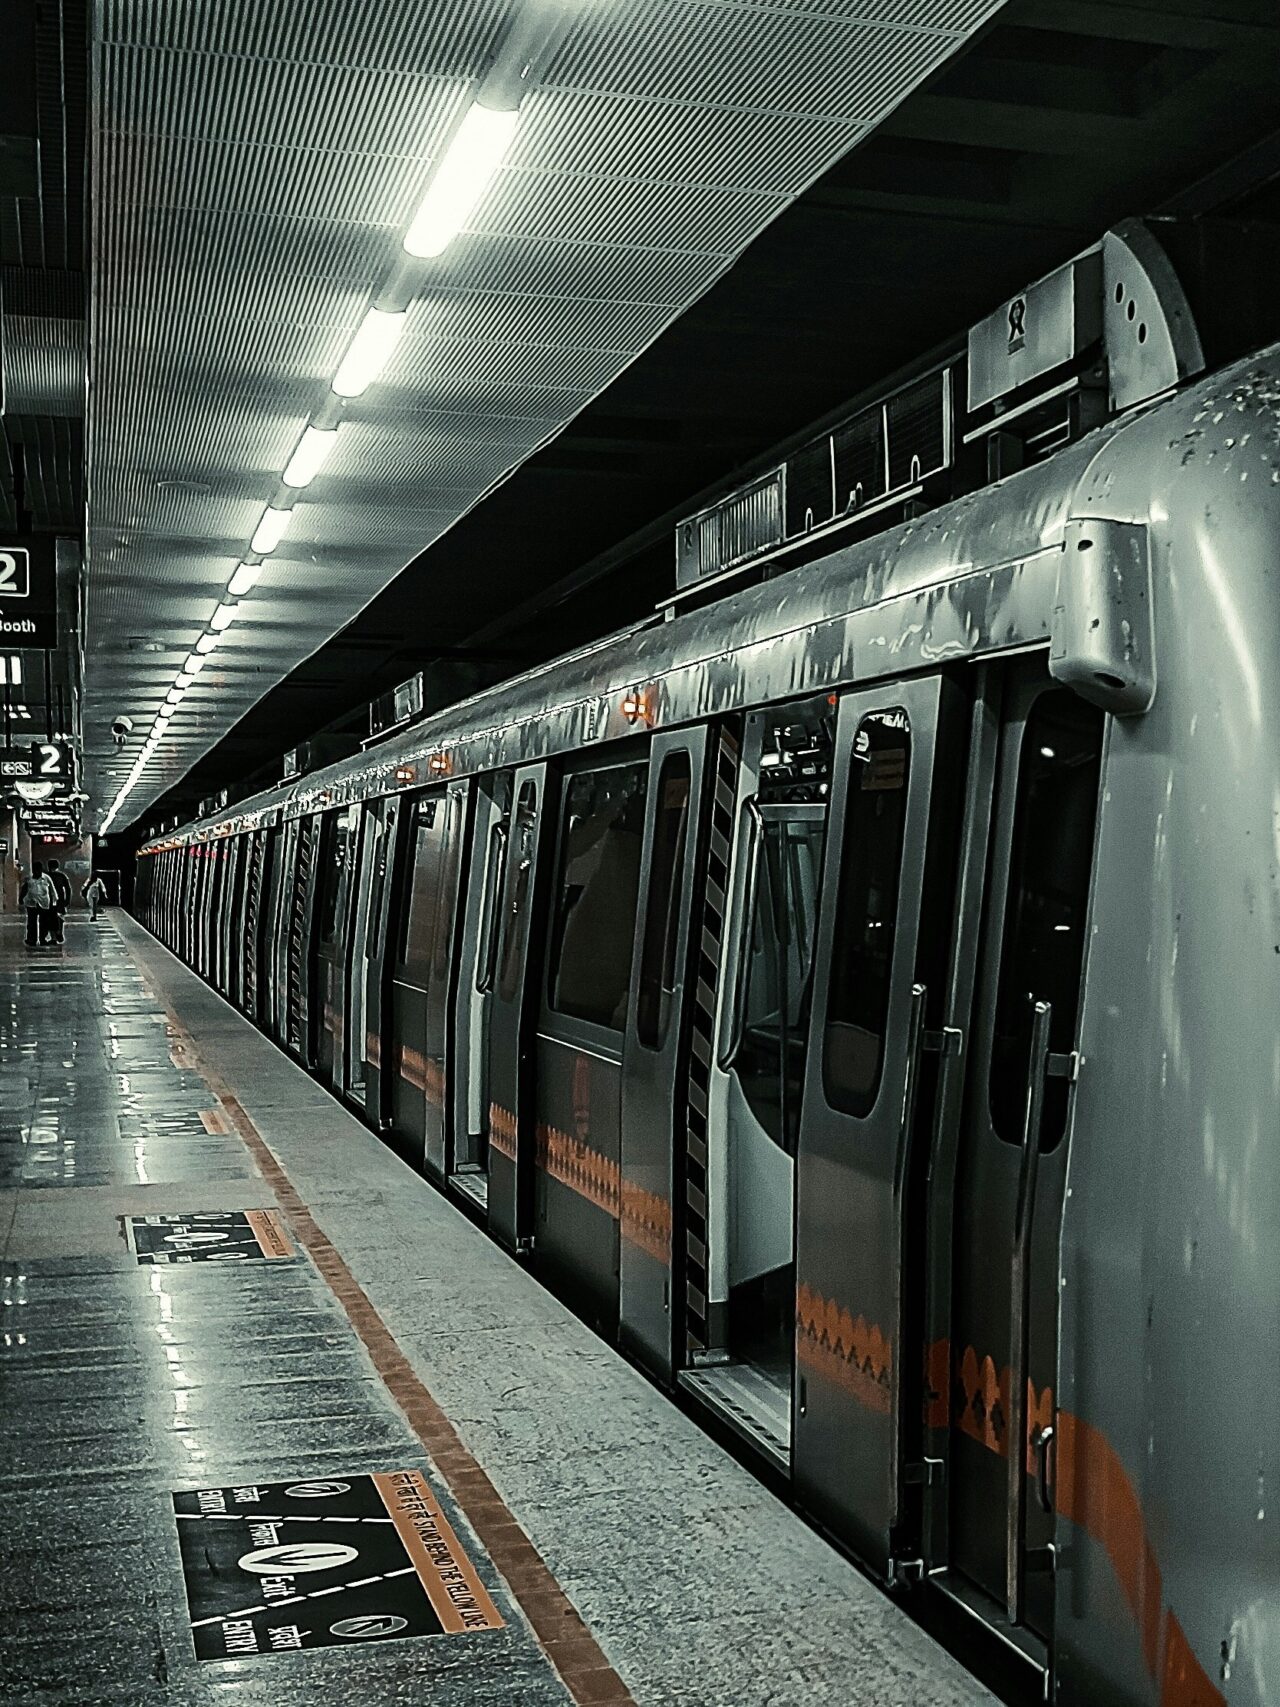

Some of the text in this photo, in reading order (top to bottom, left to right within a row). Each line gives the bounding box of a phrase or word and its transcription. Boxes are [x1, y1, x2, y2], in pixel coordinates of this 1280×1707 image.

[0, 553, 17, 591] 2
[39, 745, 61, 774] 2
[197, 1489, 227, 1513] ENTRY
[248, 1522, 284, 1547] निकास
[414, 1520, 443, 1543] STAND
[425, 1542, 455, 1566] BEHIND
[438, 1566, 464, 1581] THE
[259, 1575, 296, 1598] Exit
[445, 1577, 478, 1610] YELLOW
[460, 1608, 489, 1628] LINE
[222, 1619, 259, 1653] ENTRY
[267, 1624, 313, 1649] प्रवेश
